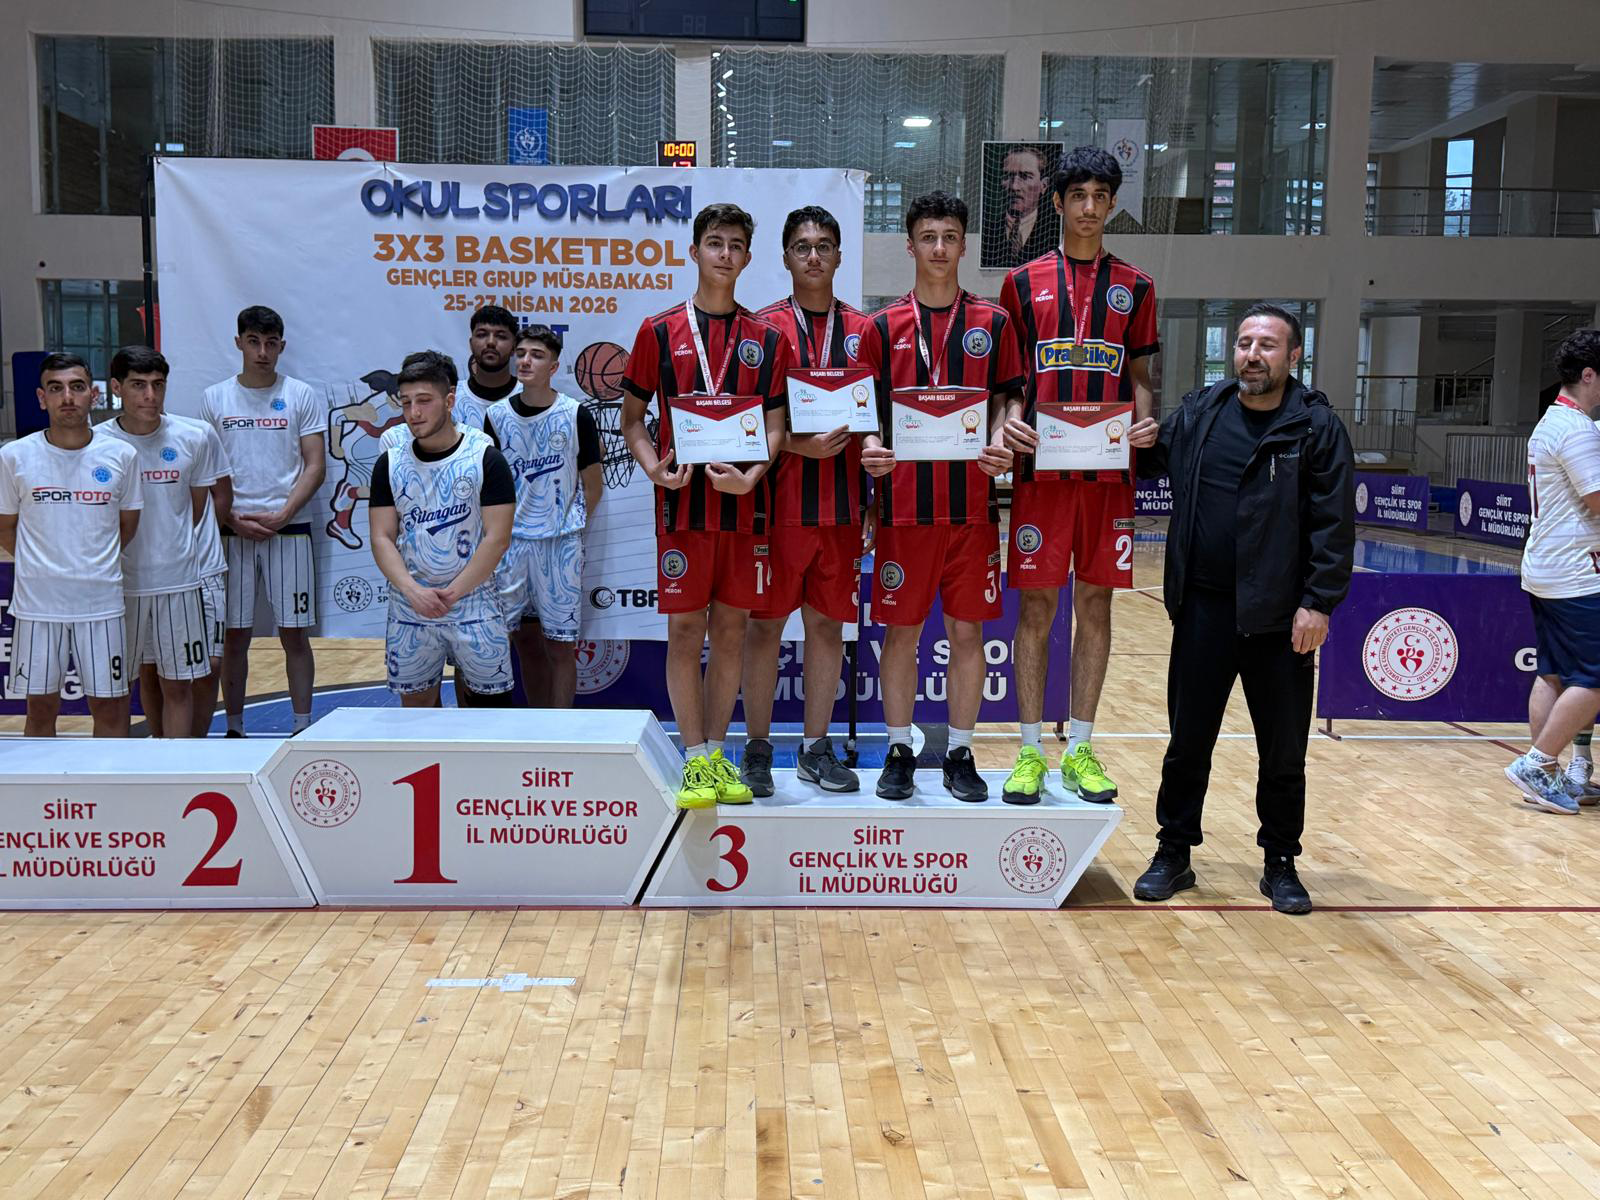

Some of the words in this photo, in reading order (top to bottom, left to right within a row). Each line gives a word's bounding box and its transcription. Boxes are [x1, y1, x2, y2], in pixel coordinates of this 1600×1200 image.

[664, 143, 695, 157] 10:00
[361, 179, 480, 217] OKUL
[482, 182, 692, 221] SPORLARI
[373, 234, 445, 263] 3X3
[456, 235, 685, 267] BASKETBOL
[386, 268, 477, 289] GENÇLER
[483, 271, 537, 289] GRUP
[543, 268, 673, 290] MÜSABAKASI
[443, 294, 497, 311] 25-27
[502, 291, 564, 313] NİSAN
[569, 296, 618, 314] 2026
[141, 470, 179, 480] TOTO
[1407, 499, 1422, 510] SPOR
[1479, 506, 1503, 520] GENÇLİK
[1503, 511, 1512, 521] VE
[1513, 512, 1530, 524] SPOR
[293, 592, 309, 614] 13
[184, 640, 204, 666] 10
[112, 655, 122, 681] 9
[522, 767, 574, 787] SİİRT
[44, 798, 97, 820] SİİRT
[456, 795, 547, 821] GENÇLİK
[551, 800, 577, 817] VE
[583, 800, 638, 817] SPOR
[392, 762, 458, 884] 1
[75, 832, 102, 848] VE
[108, 832, 166, 848] SPOR
[181, 791, 243, 887] 2
[466, 824, 484, 844] İL
[489, 824, 628, 846] MÜDÜRLÜĞÜ
[853, 825, 905, 845] SİİRT
[13, 857, 156, 877] MÜDÜRLÜĞÜ
[706, 824, 749, 893] 3
[789, 848, 878, 873] GENÇLİK
[881, 852, 908, 868] VE
[913, 852, 968, 869] SPOR
[800, 872, 816, 893] İL
[822, 872, 958, 894] MÜDÜRLÜĞÜ
